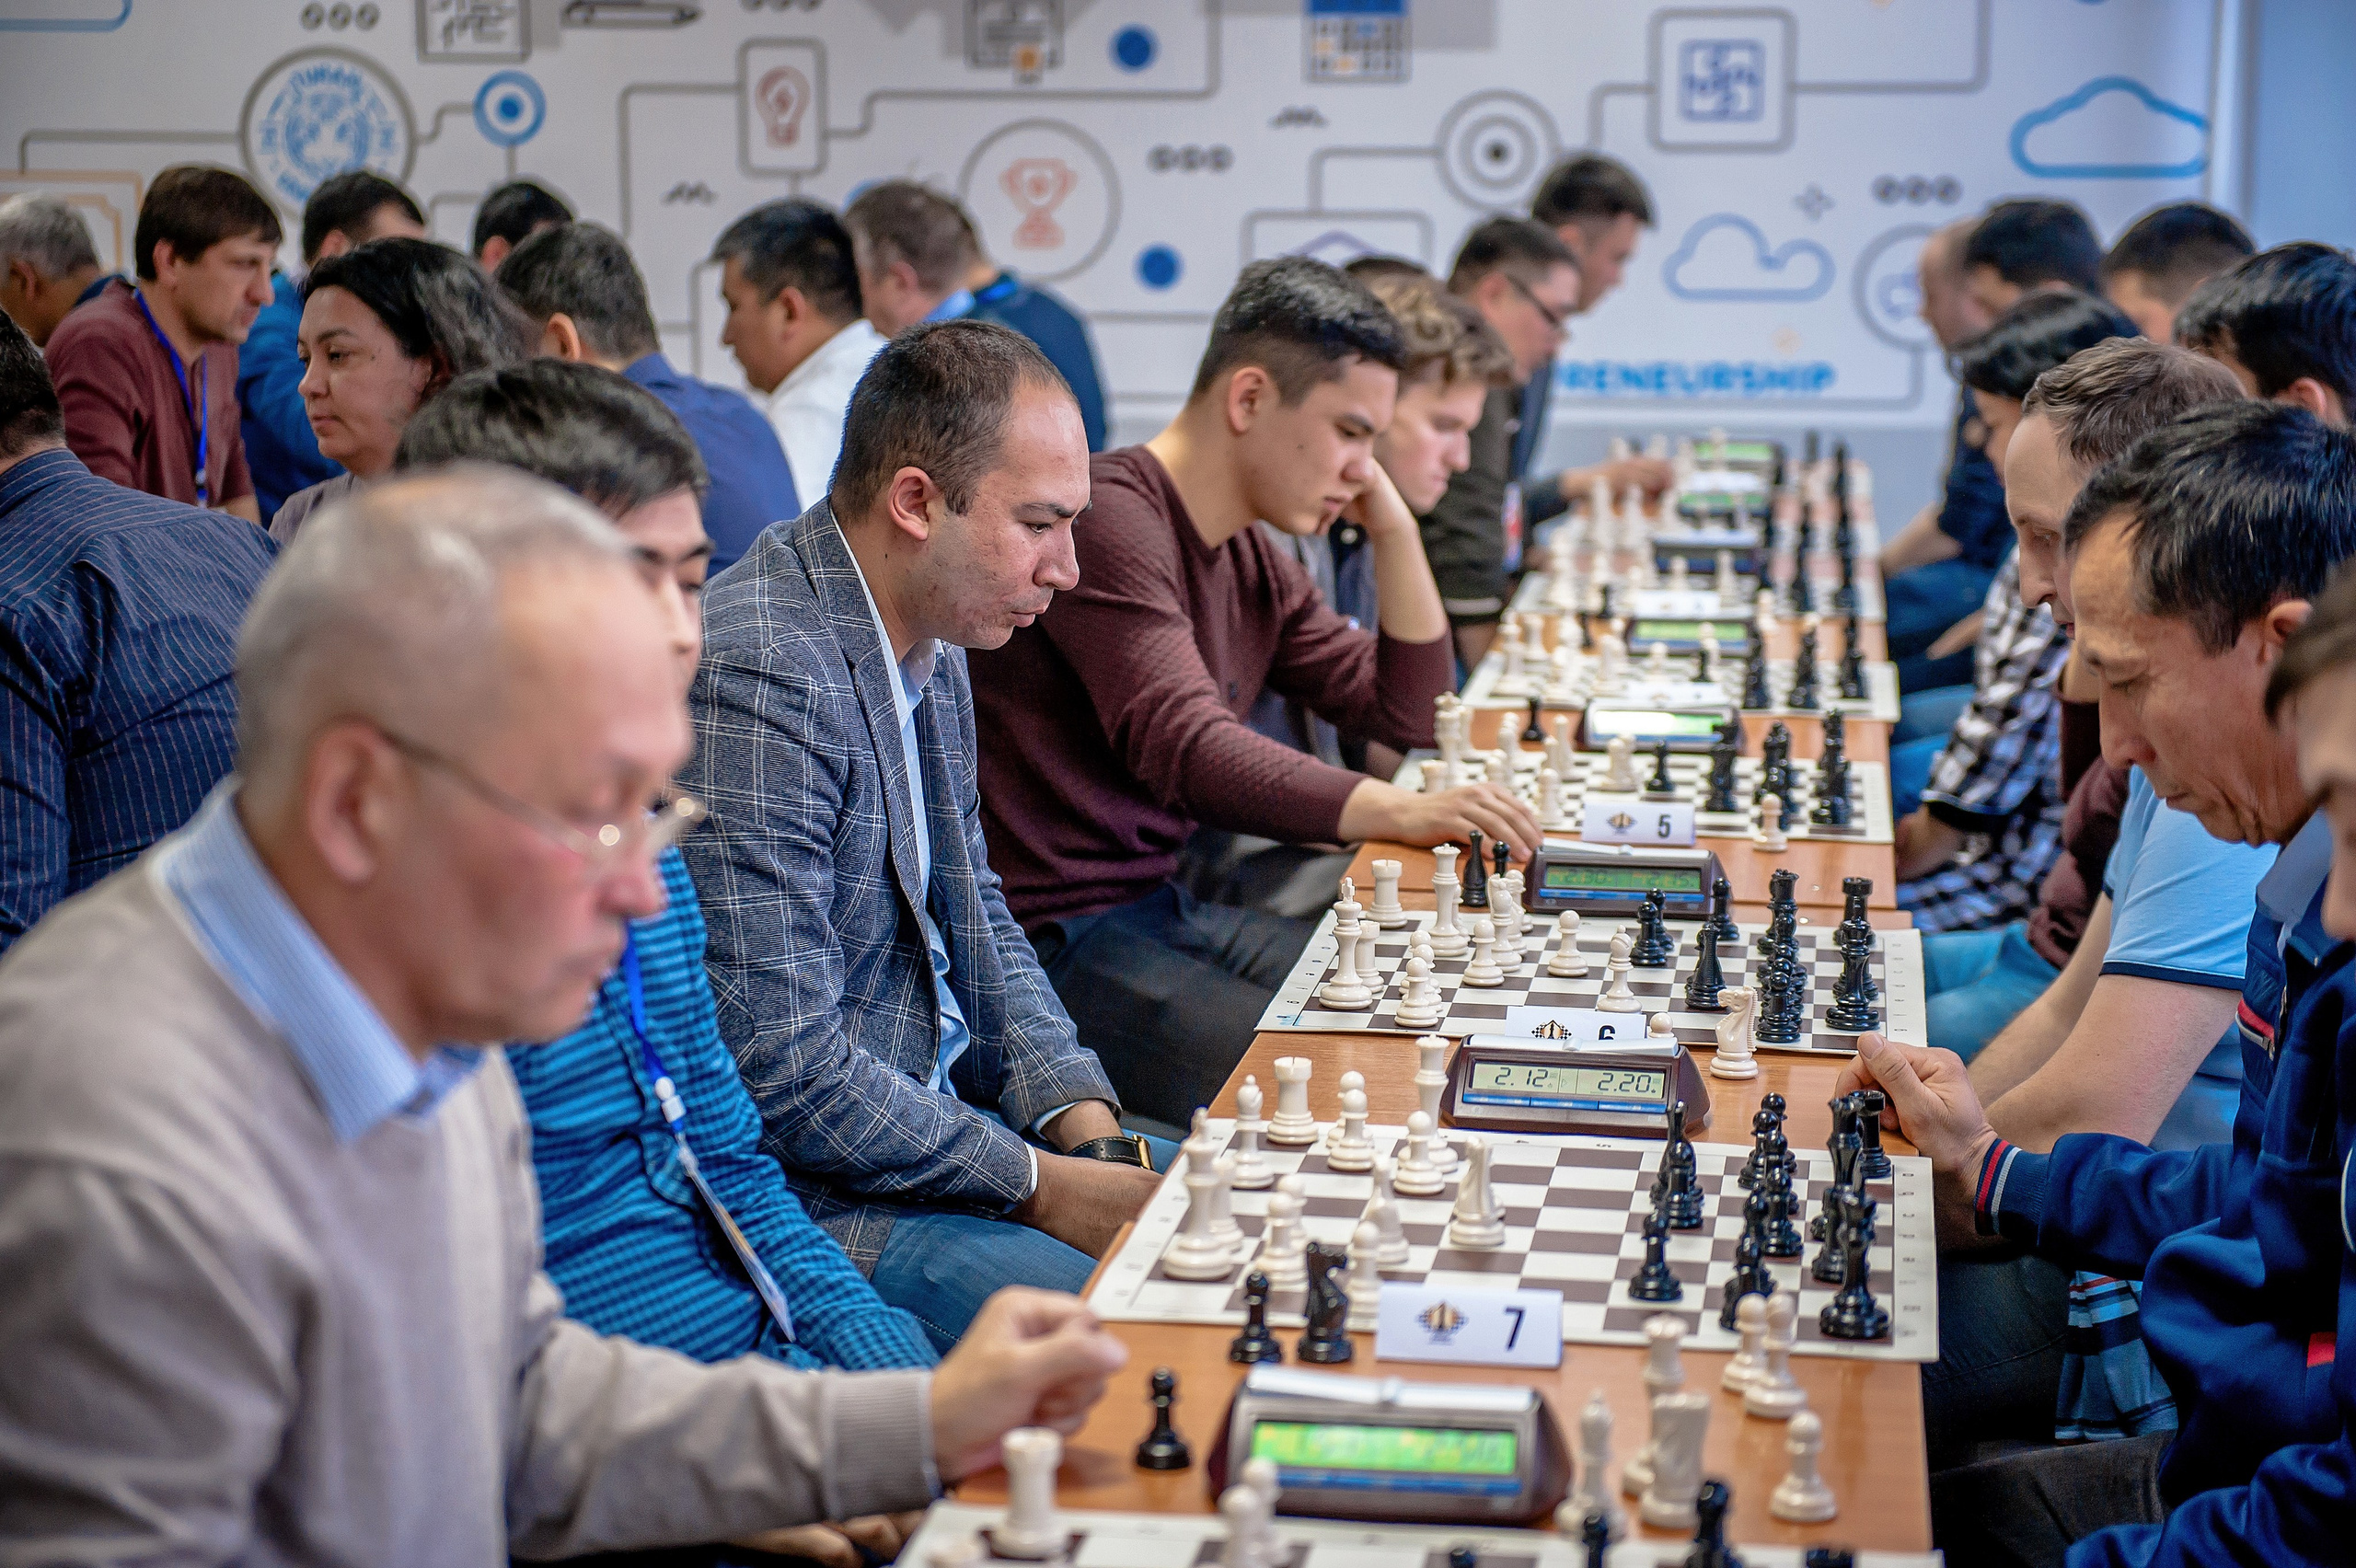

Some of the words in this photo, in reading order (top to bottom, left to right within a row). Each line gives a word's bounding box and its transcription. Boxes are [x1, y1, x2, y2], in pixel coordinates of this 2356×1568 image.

[1552, 361, 1834, 393] RENEURSHIP
[1657, 813, 1671, 838] 5
[1598, 1072, 1651, 1093] 2.20
[1505, 1306, 1526, 1351] 7
